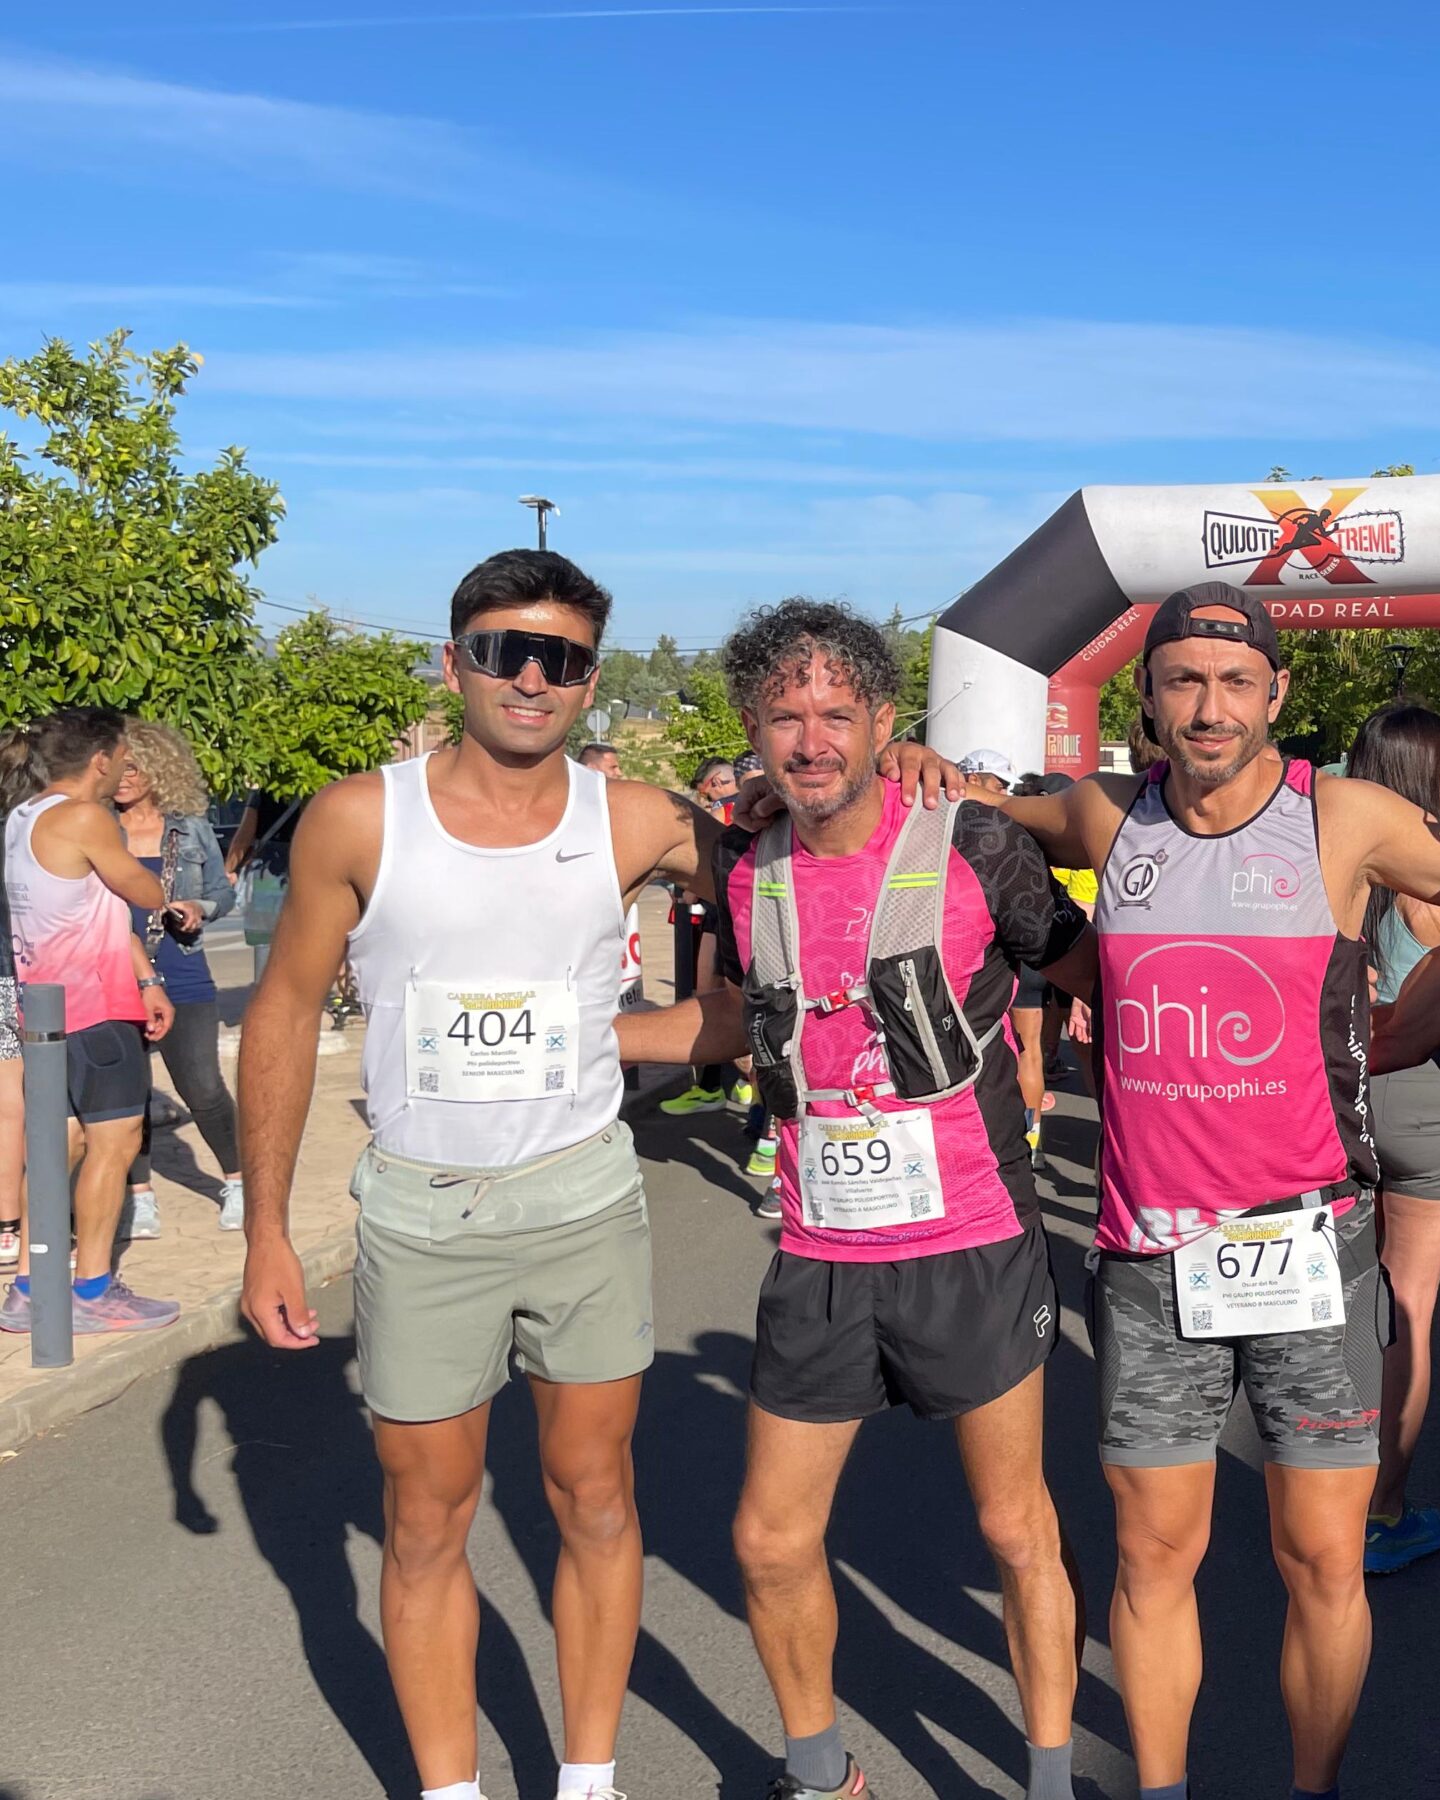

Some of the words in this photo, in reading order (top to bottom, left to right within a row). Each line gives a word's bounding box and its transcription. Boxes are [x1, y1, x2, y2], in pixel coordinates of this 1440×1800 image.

[1298, 572, 1320, 580] RACE
[1319, 556, 1341, 577] SERIES
[1334, 602, 1395, 617] REAL
[1082, 630, 1118, 662] CIUDAD
[1116, 610, 1141, 632] REAL
[1231, 866, 1273, 901] phi
[447, 992, 493, 1001] CARRERA
[494, 990, 537, 1001] POPULAR
[447, 1009, 537, 1047] 404
[1114, 984, 1209, 1072] phi
[1119, 1077, 1287, 1104] www.grupophi.es
[821, 1139, 891, 1177] 659
[1253, 1218, 1294, 1231] POPULAR
[1216, 1238, 1293, 1279] 677
[1222, 1291, 1232, 1299] PHI
[1254, 1289, 1300, 1298] POLIDEPORTIVO
[1226, 1301, 1257, 1309] VETERANO
[1263, 1299, 1298, 1307] MASCULINO
